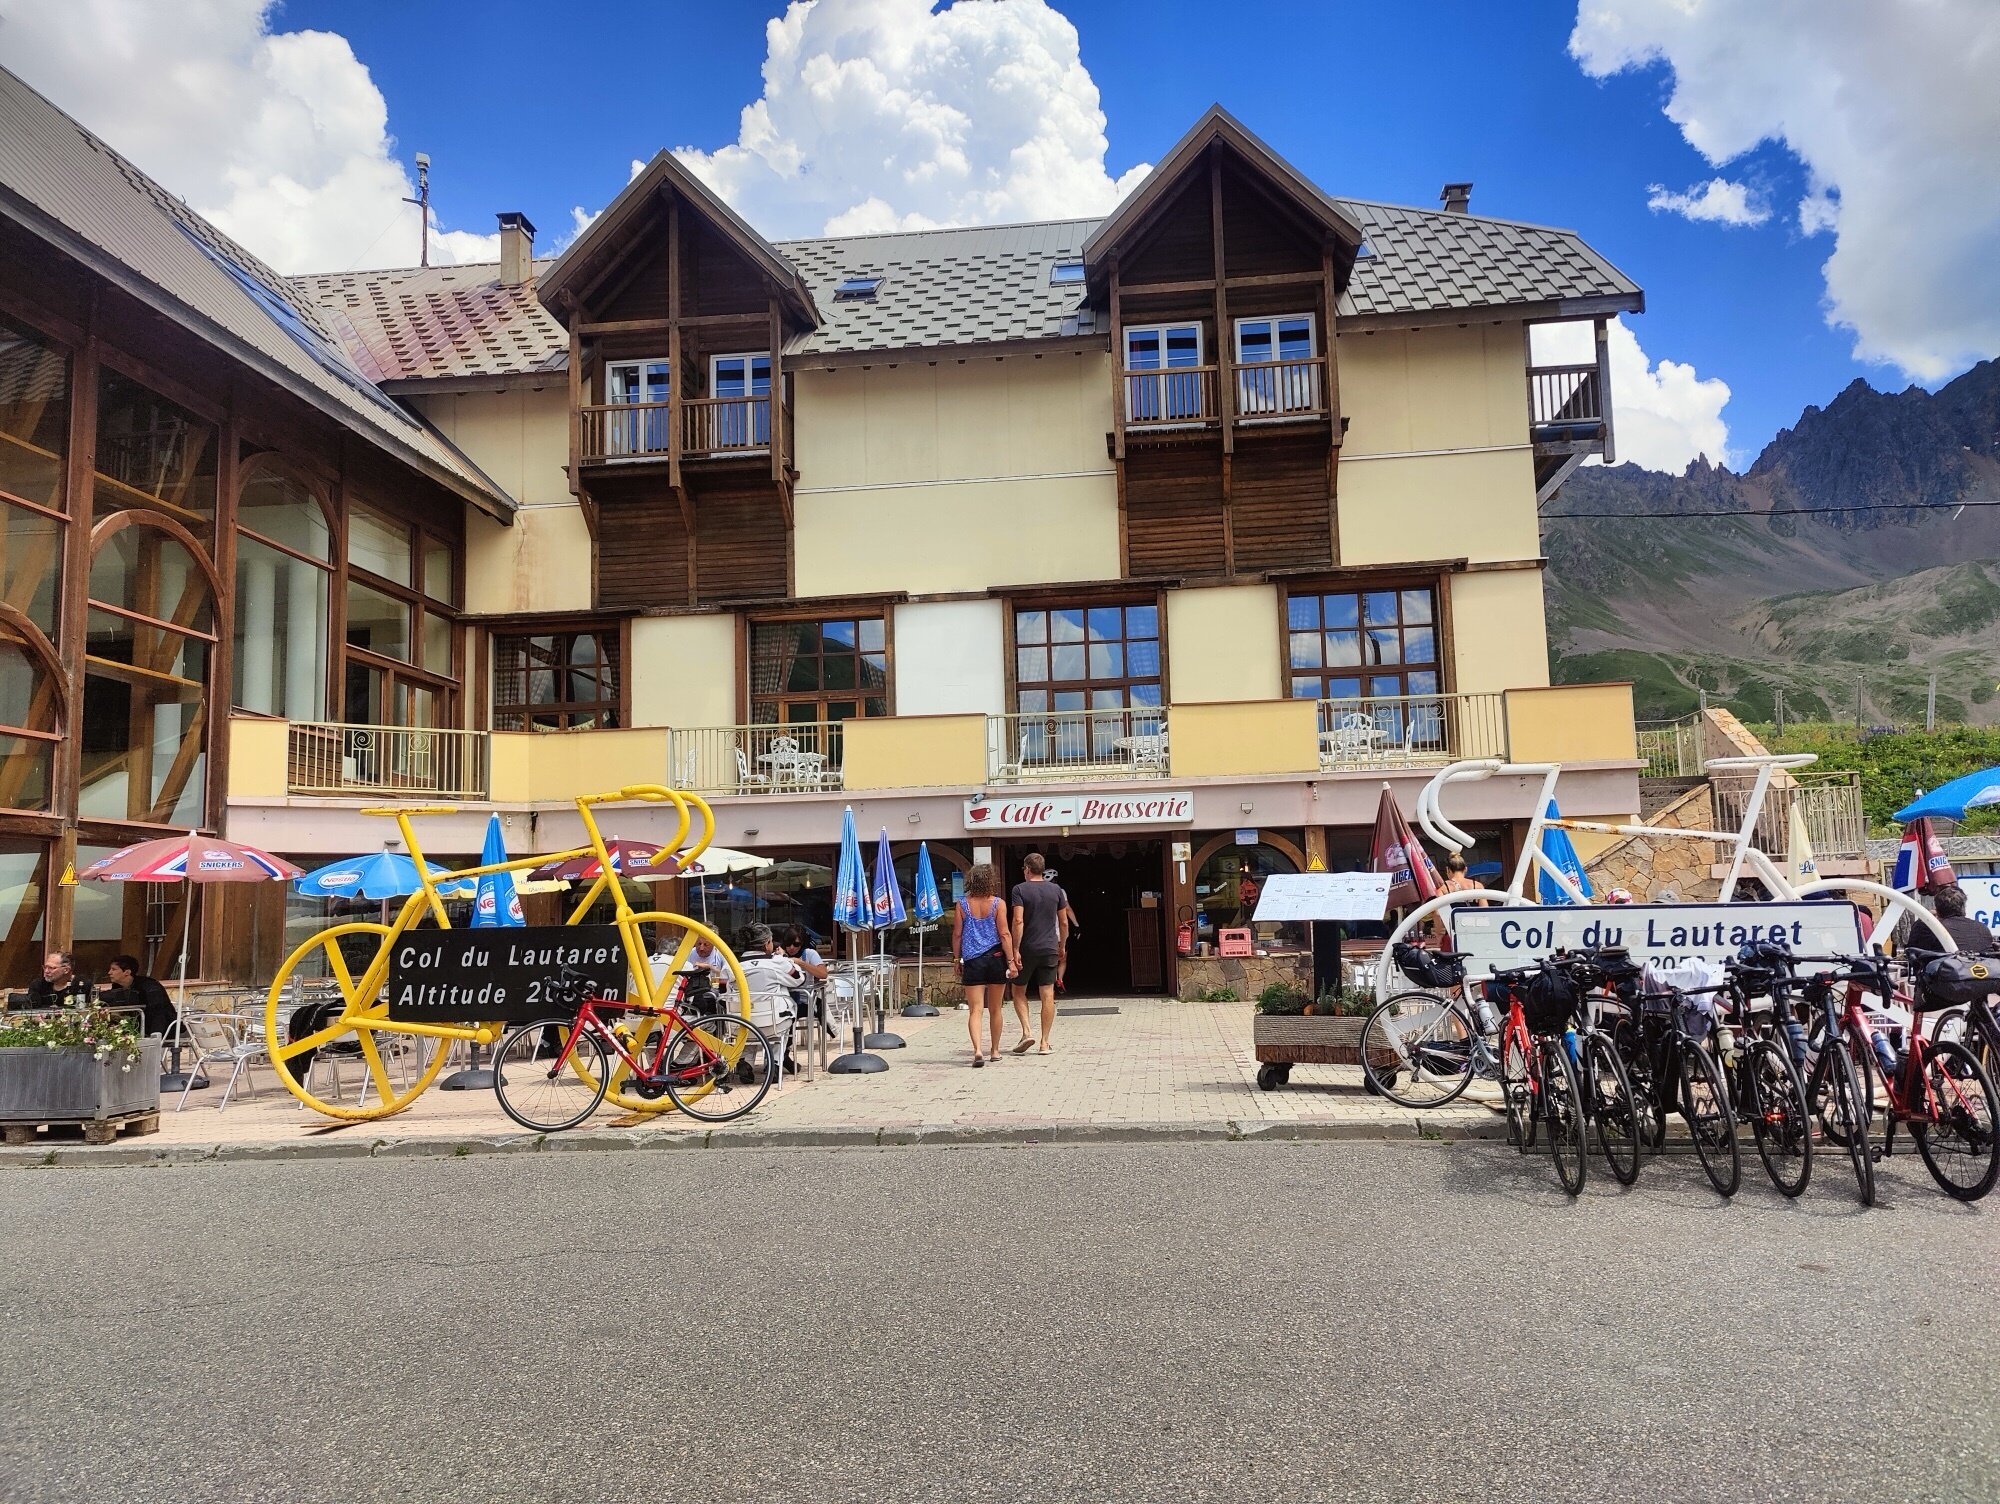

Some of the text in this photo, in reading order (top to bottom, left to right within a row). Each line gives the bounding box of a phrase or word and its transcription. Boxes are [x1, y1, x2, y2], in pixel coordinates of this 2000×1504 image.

[1000, 802, 1053, 825] Café
[1082, 798, 1188, 820] Brasserie
[1930, 857, 1949, 870] SNIC
[1501, 919, 1802, 949] Col du Lautaret
[400, 944, 620, 969] Col du Lautaret
[399, 983, 506, 1006] Altitude
[603, 988, 618, 1001] m
